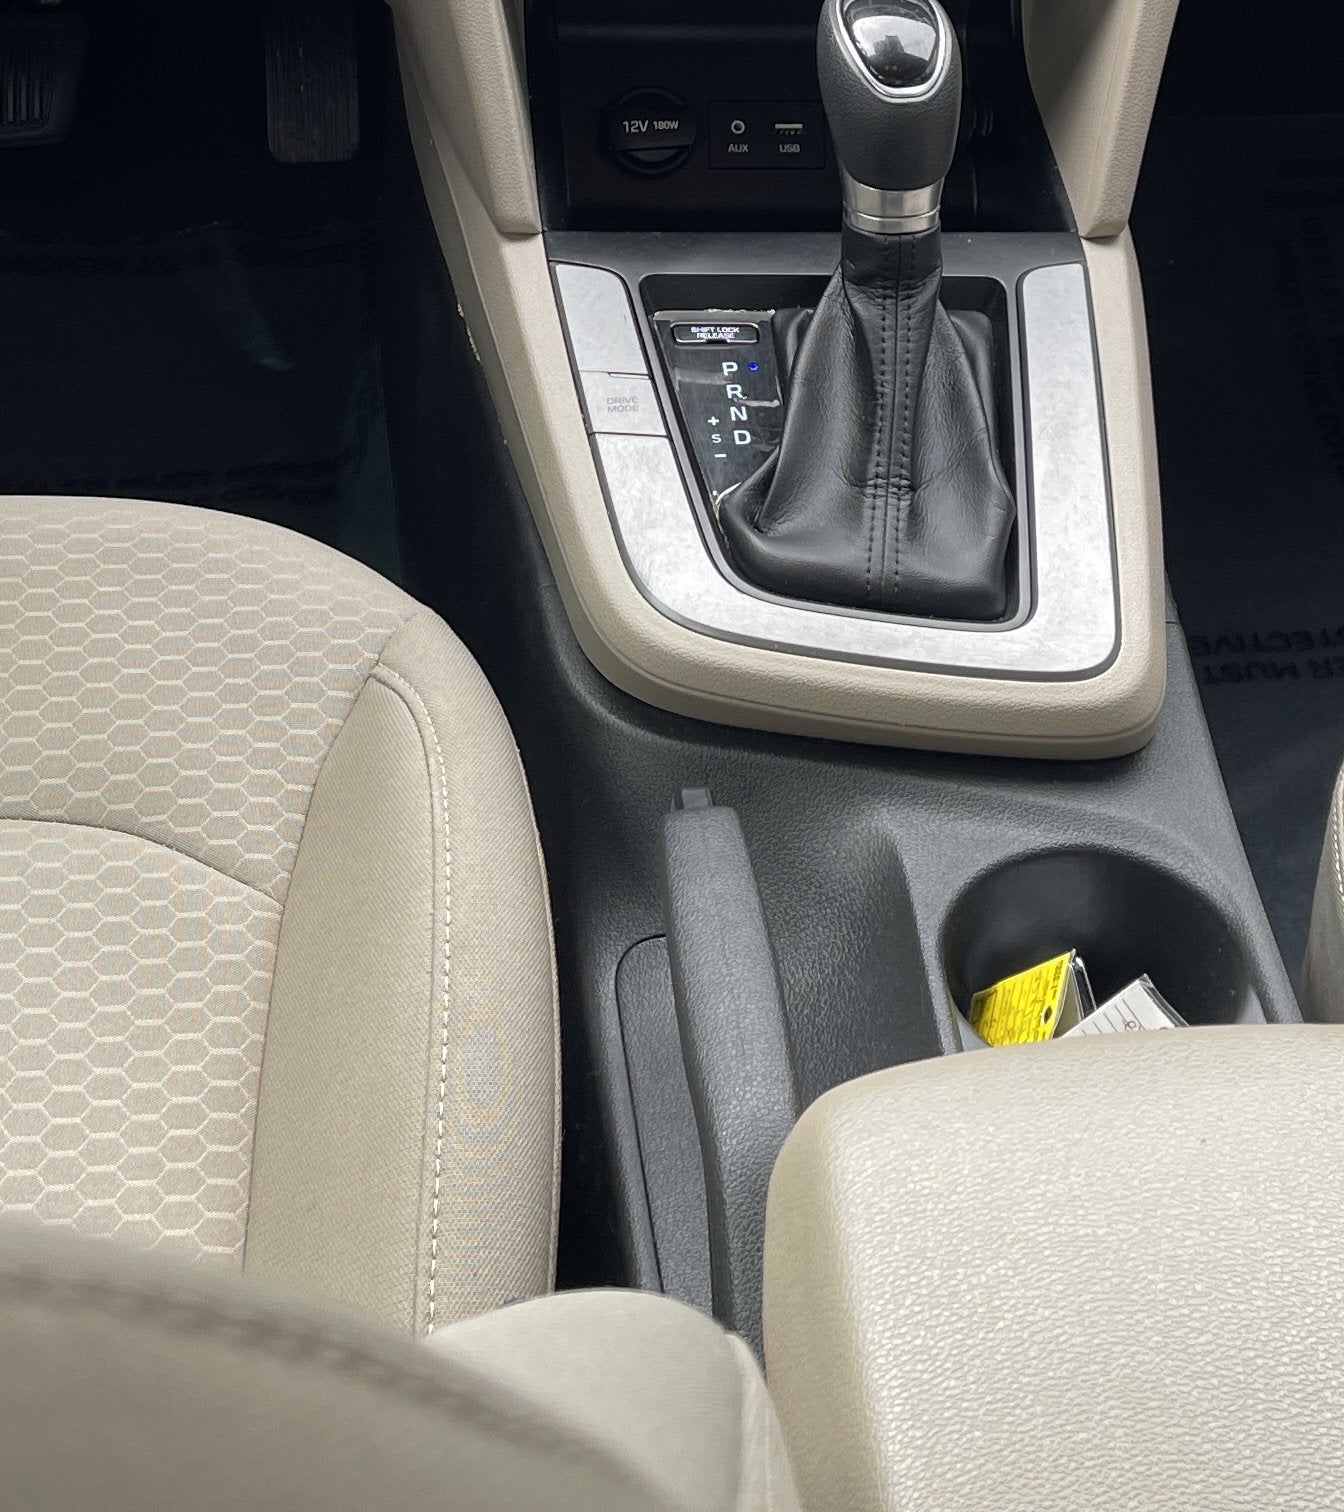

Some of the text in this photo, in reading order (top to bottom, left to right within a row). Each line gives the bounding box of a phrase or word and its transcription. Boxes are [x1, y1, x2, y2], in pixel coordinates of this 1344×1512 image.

[622, 119, 649, 133] 12V
[727, 143, 749, 154] AUX
[779, 143, 800, 154] USB
[690, 326, 740, 334] SHIFT LOCK
[696, 332, 736, 340] RELEASE
[722, 361, 739, 377] P
[726, 384, 744, 399] R
[607, 396, 638, 405] DRIVE
[607, 405, 639, 414] MODE
[730, 406, 748, 422] N
[711, 433, 722, 444] S
[733, 430, 752, 445] D
